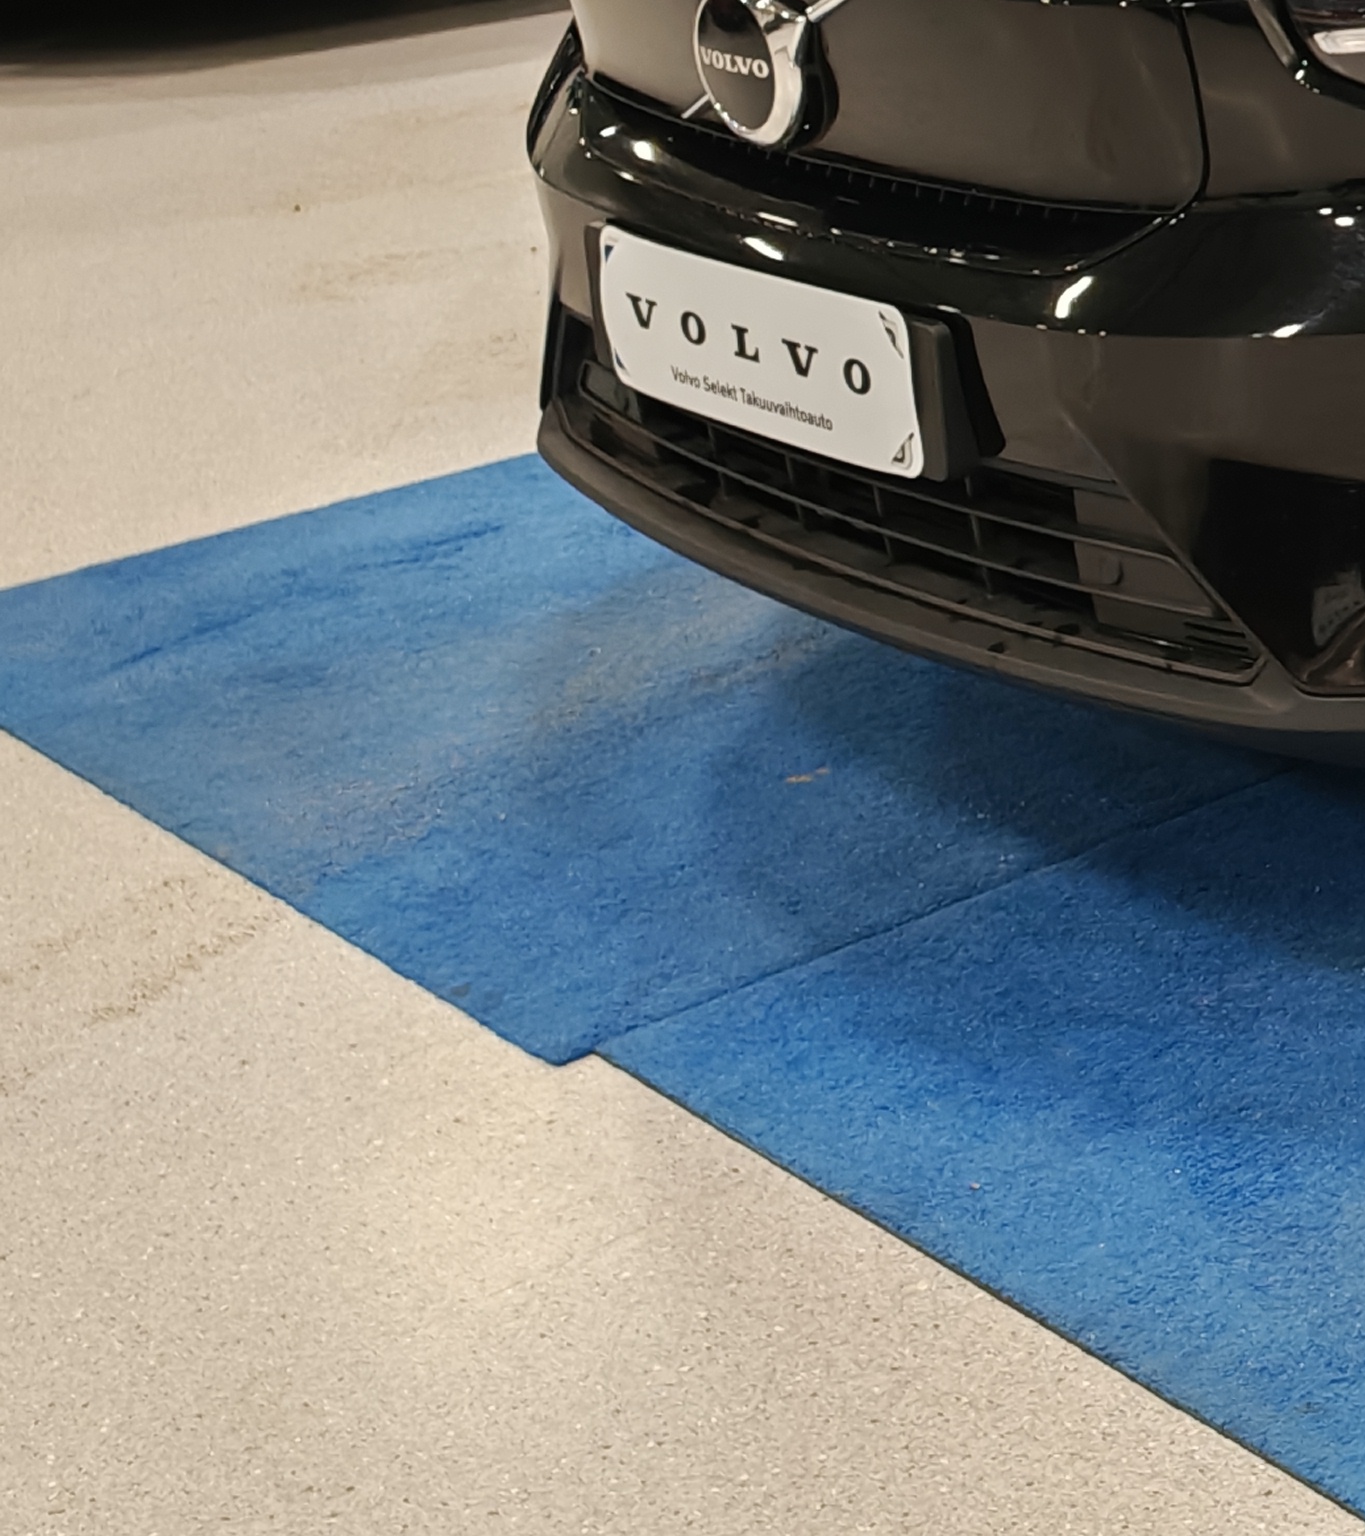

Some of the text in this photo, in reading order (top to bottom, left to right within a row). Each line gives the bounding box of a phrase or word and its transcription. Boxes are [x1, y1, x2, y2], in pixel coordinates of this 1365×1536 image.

[699, 45, 770, 79] VOLVO
[625, 292, 872, 396] VOLVO
[670, 364, 834, 432] Volvo Selekt Takuuvaihtoauto
